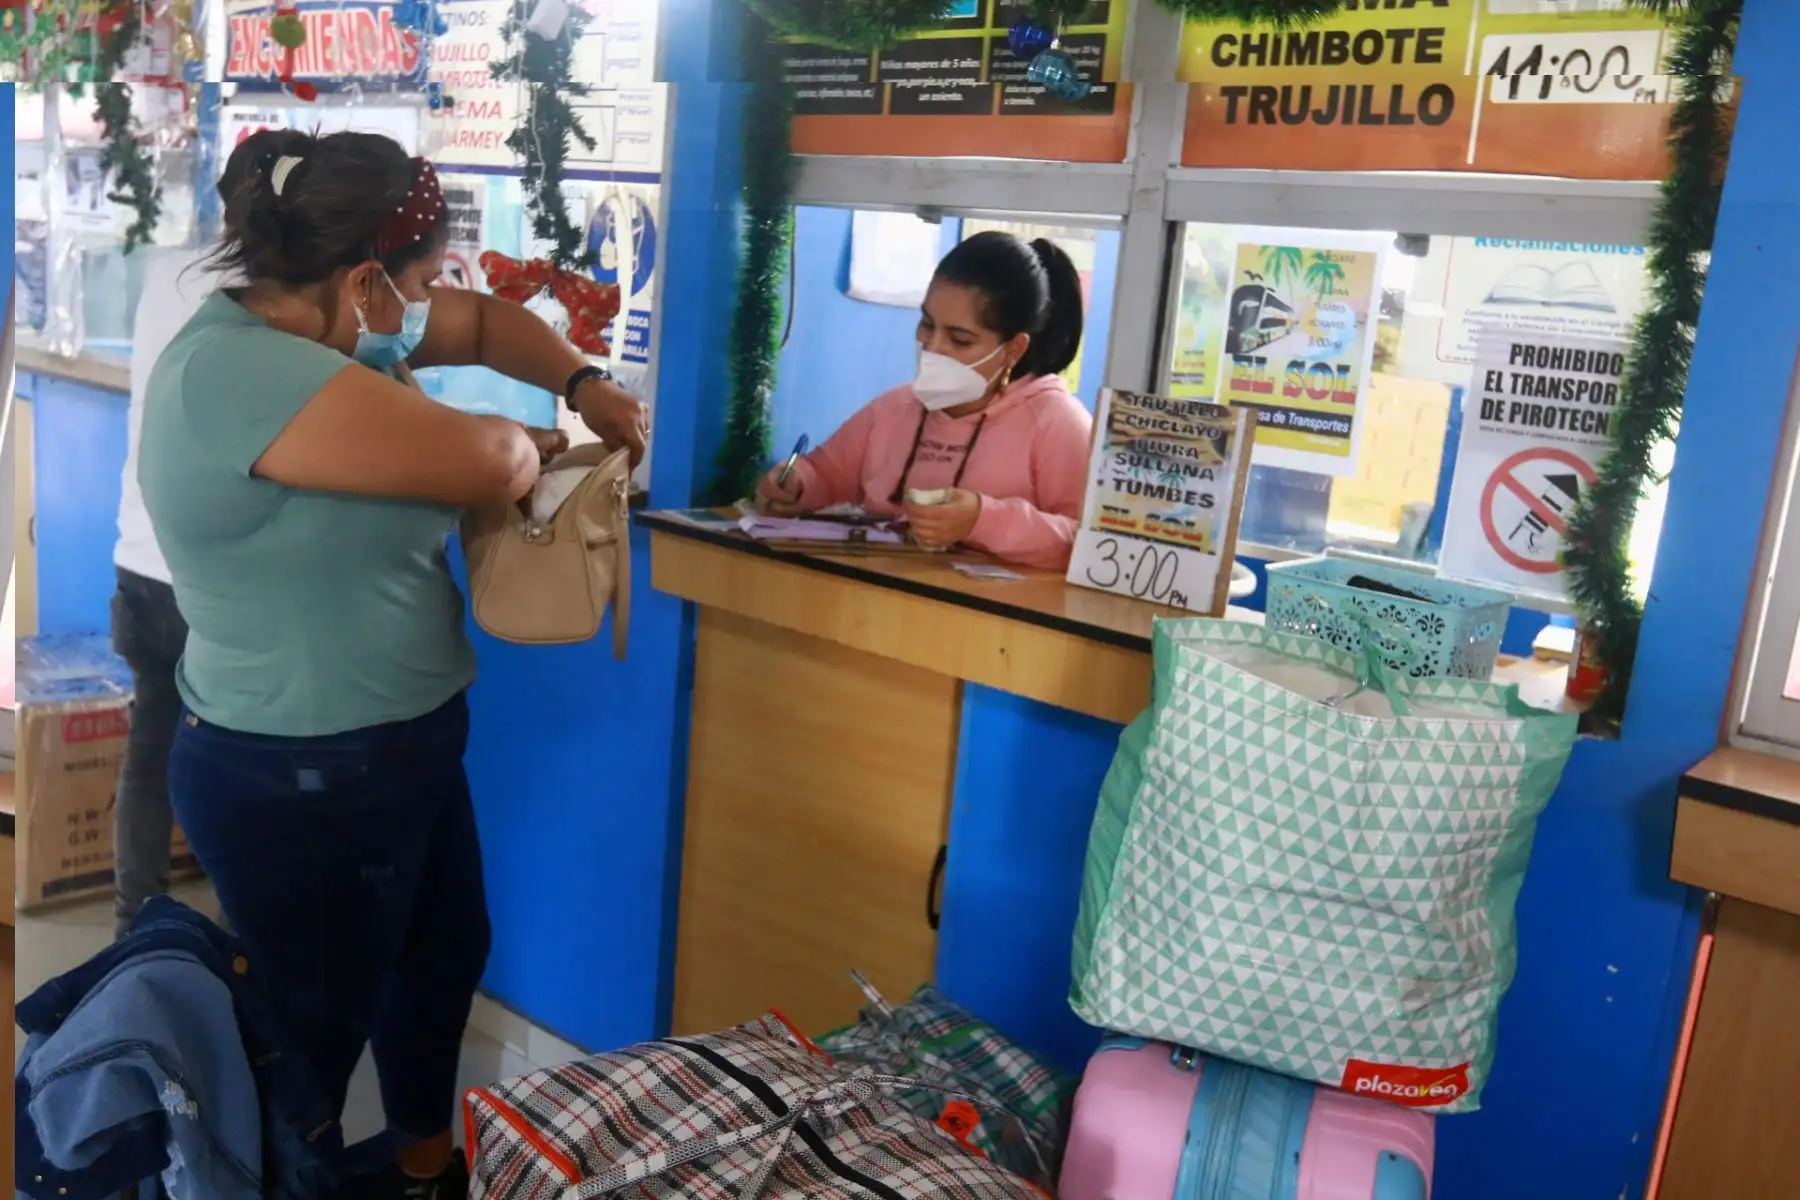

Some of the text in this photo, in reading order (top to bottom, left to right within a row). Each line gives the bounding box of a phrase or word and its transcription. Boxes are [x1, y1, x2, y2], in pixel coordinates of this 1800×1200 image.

[1211, 27, 1445, 67] CHIMBOTE
[1220, 83, 1455, 126] TRUJILLO
[1509, 343, 1625, 377] PROHIBIDO
[1230, 354, 1275, 395] EL
[1282, 360, 1357, 405] SOL
[1484, 370, 1619, 407] EL TRANSPOR
[1272, 411, 1286, 423] de
[1288, 412, 1350, 434] Transportes
[1480, 398, 1611, 435] DE PIROTECN
[1115, 452, 1214, 482] SULLANA
[1112, 478, 1215, 509] TUMBES
[1087, 538, 1178, 600] 3:00
